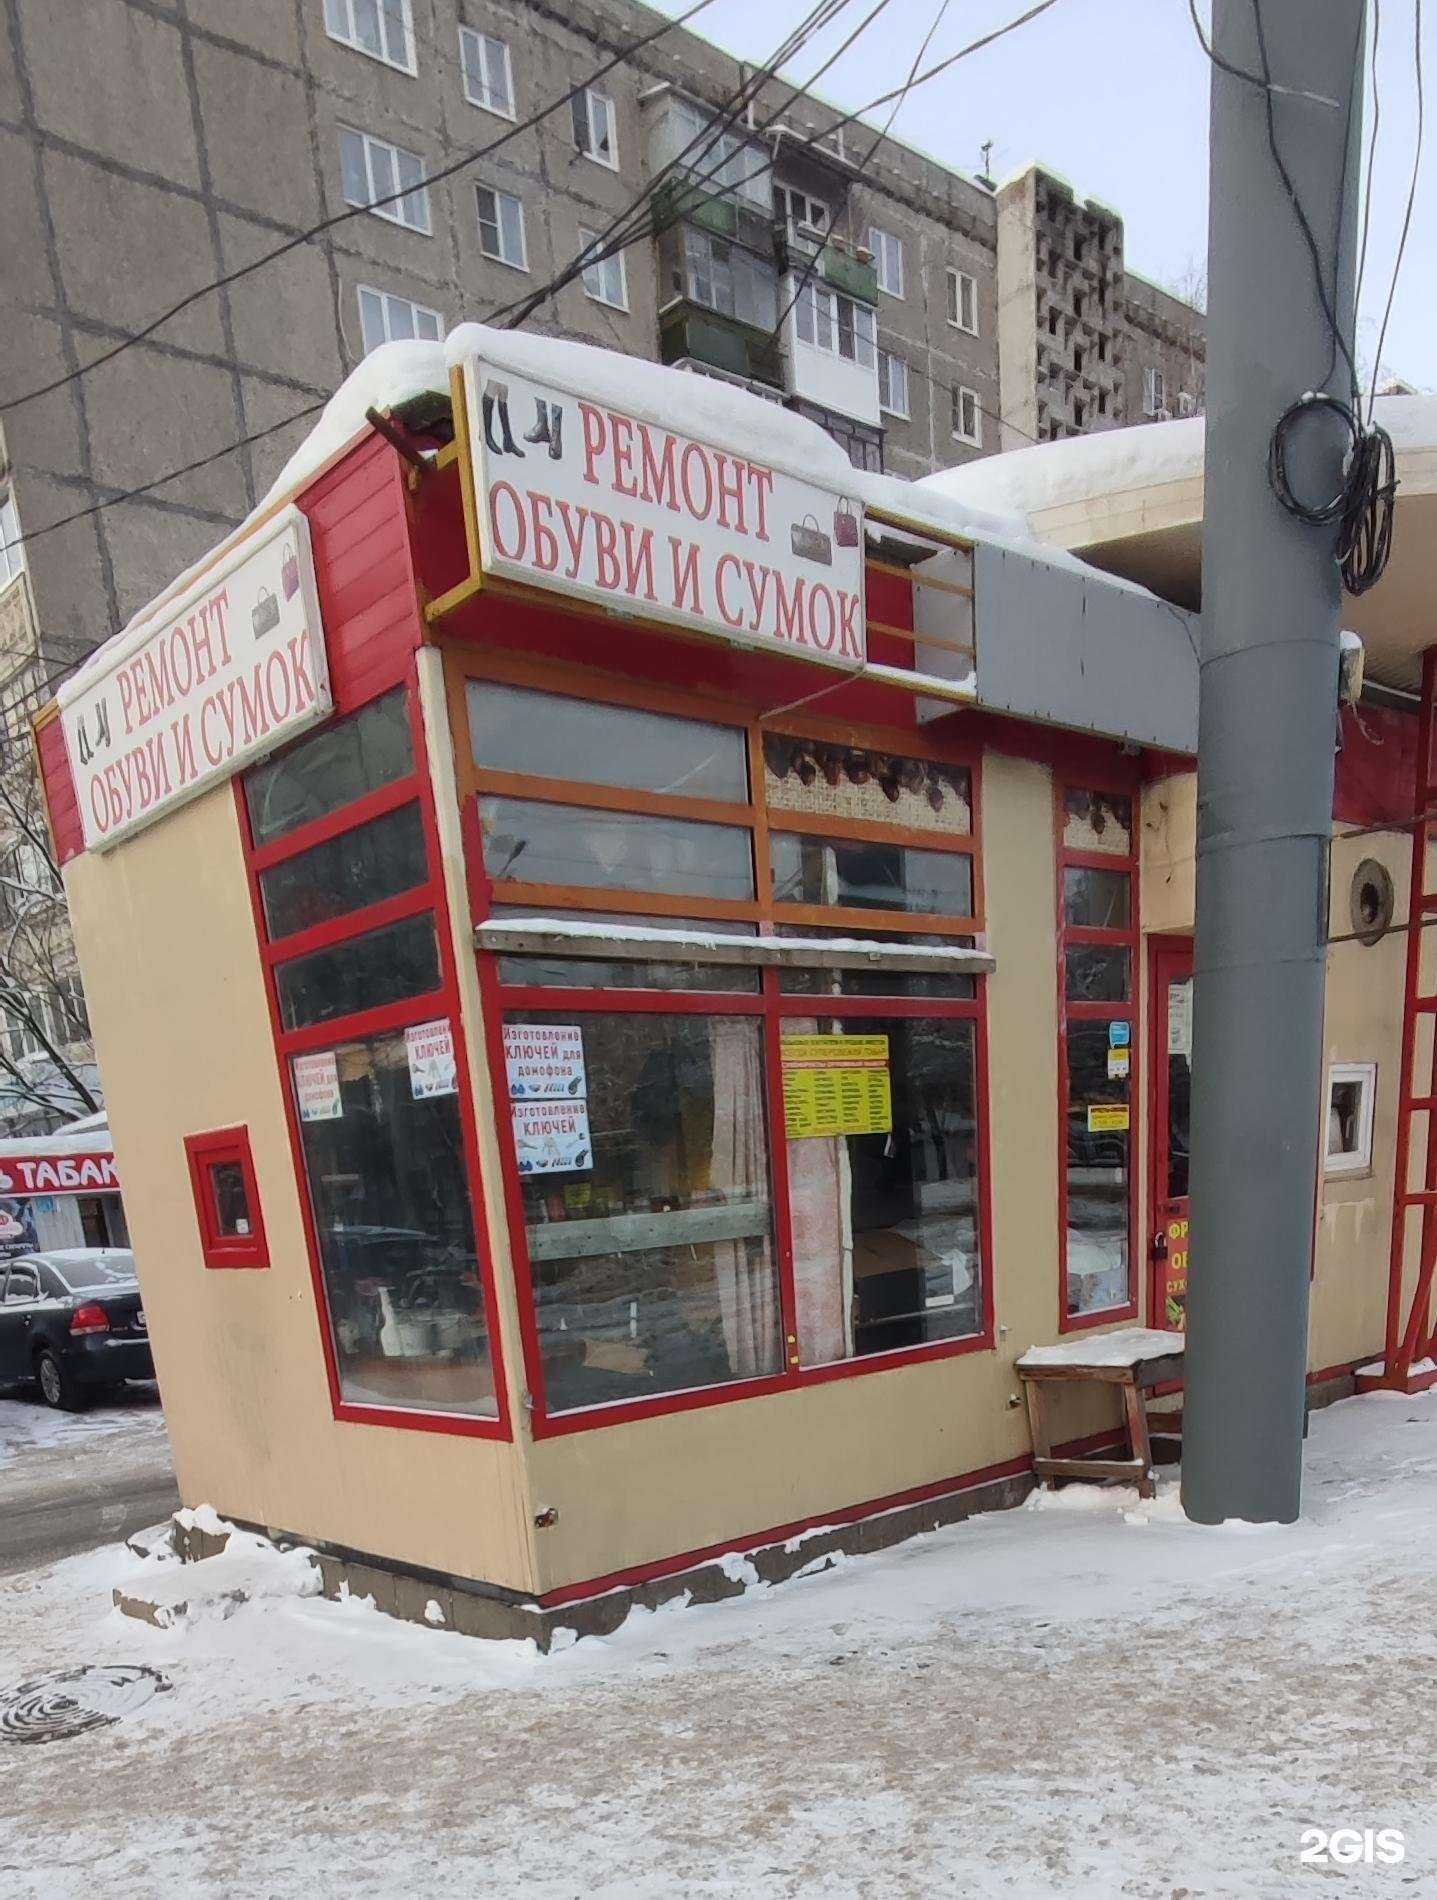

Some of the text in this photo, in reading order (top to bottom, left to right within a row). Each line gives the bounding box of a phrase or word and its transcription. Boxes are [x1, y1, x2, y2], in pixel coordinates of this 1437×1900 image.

[578, 402, 775, 542] РЕМОНТ
[489, 480, 863, 659] ОБУВИ И СУМОК
[90, 628, 316, 833] ОБУВИ И СУМОК
[116, 589, 231, 735] РЕМОНТ
[505, 1042, 581, 1061] КЛЮЧЕЙ для
[523, 1116, 576, 1136] КЛЮЧЕЙ
